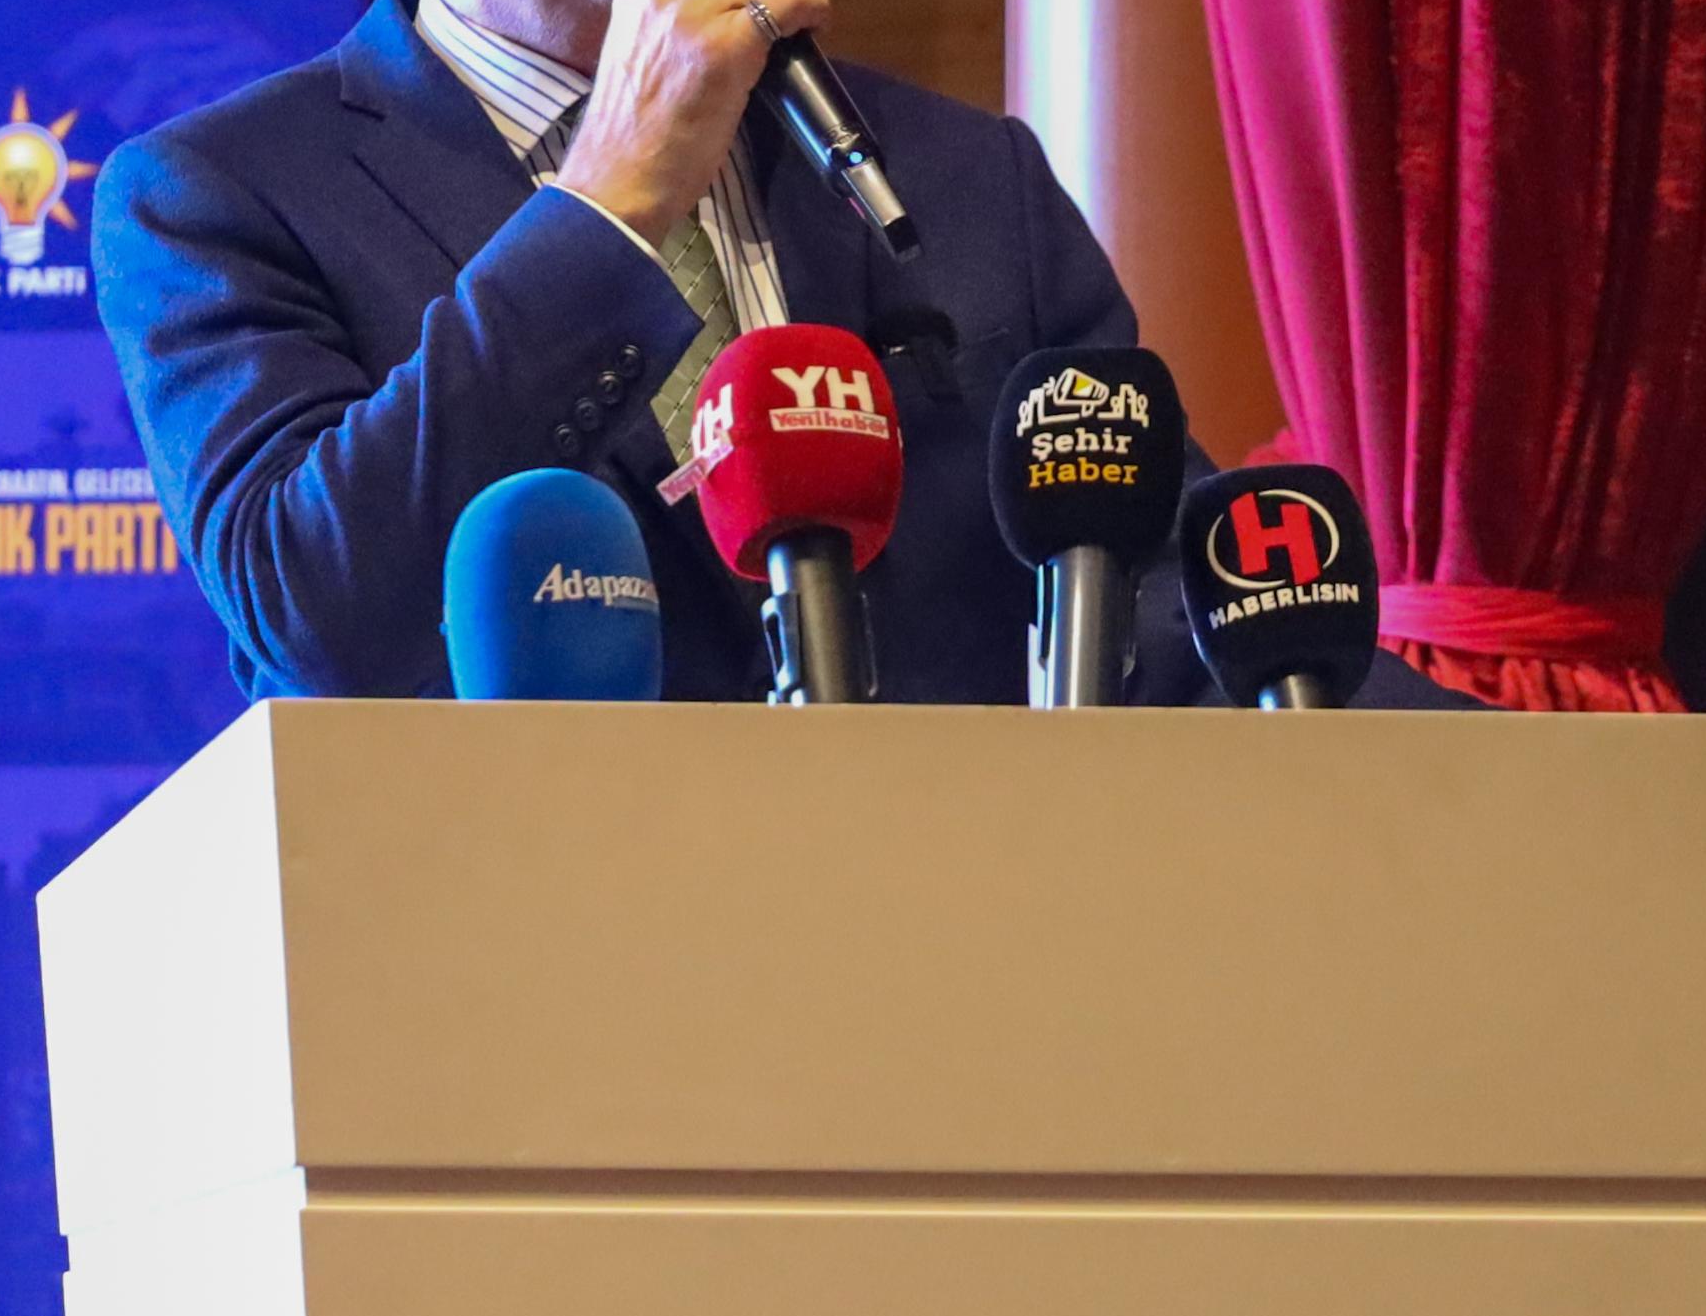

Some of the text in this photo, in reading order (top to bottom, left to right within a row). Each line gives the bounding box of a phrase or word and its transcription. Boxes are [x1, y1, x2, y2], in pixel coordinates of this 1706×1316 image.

[770, 365, 875, 413] YH
[1031, 427, 1133, 462] Şehir
[1028, 457, 1139, 488] Haber
[1229, 491, 1321, 585] H
